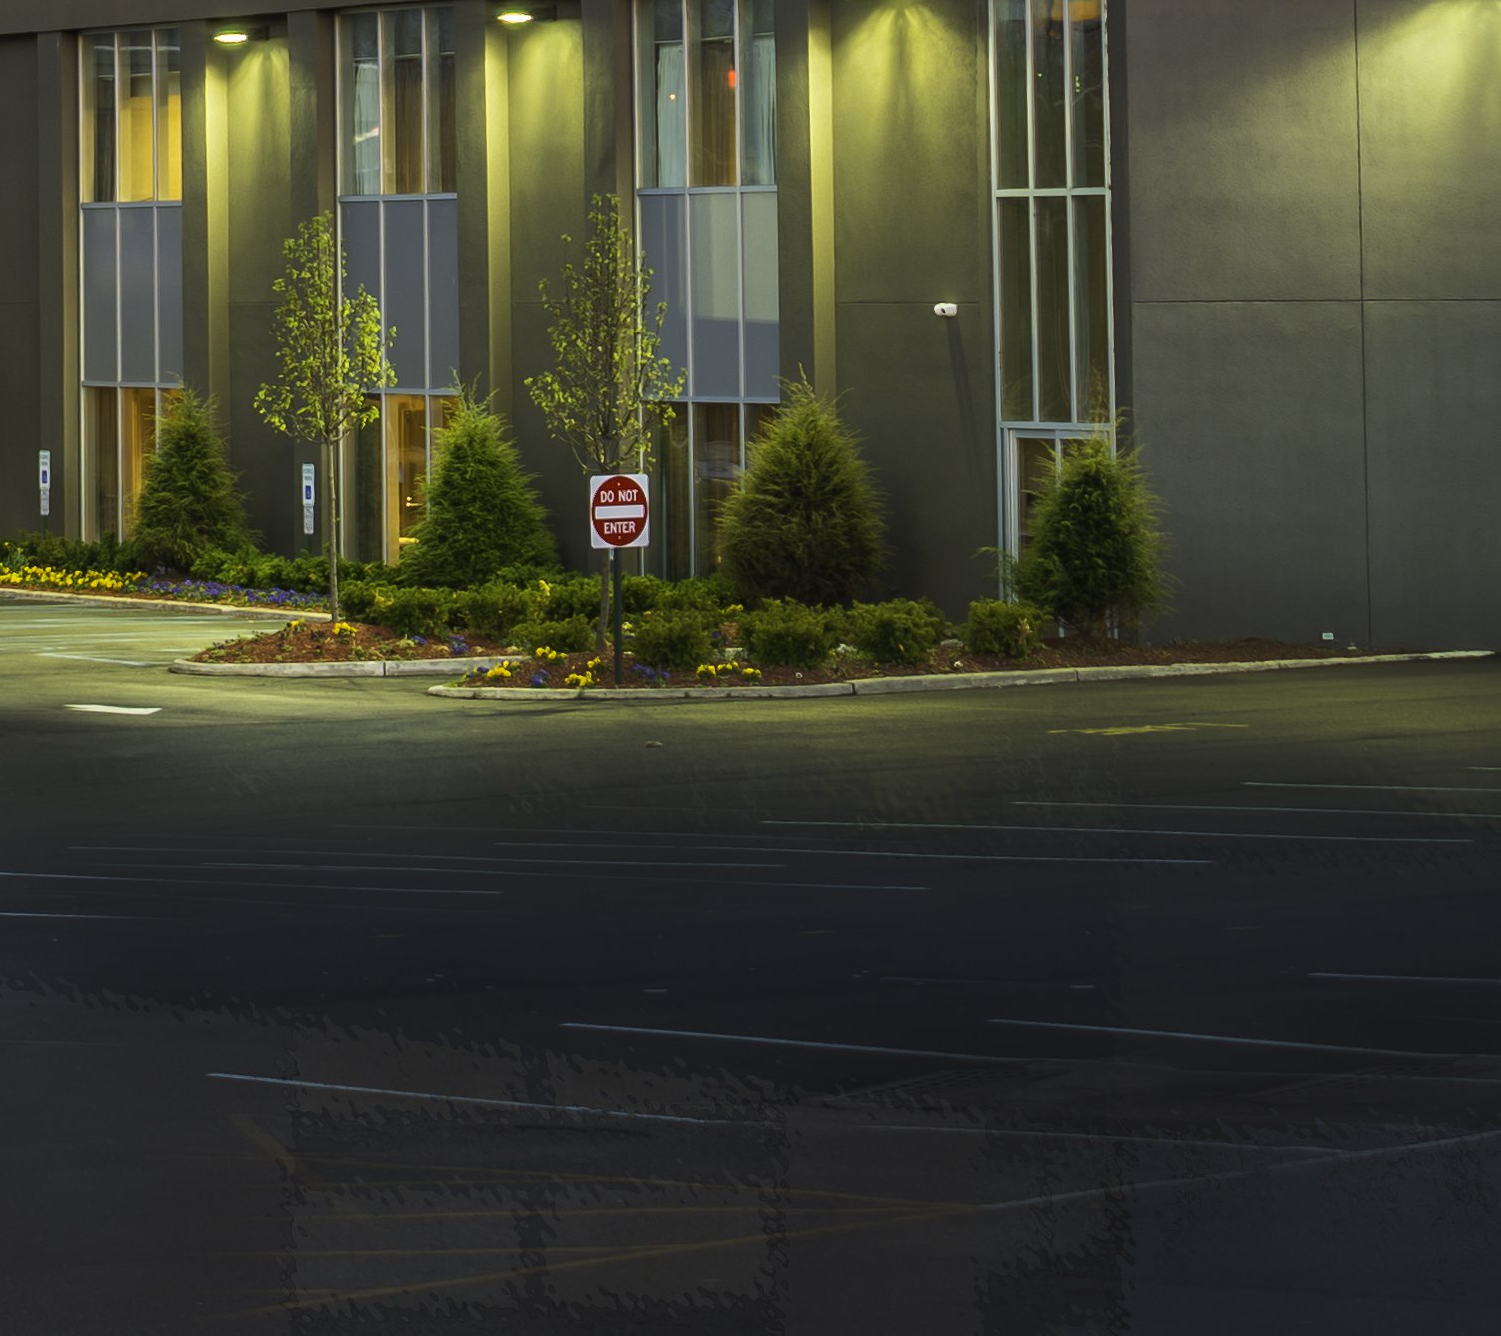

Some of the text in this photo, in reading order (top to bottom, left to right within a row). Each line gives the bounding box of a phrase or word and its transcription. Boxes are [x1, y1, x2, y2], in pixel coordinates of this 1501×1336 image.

[600, 489, 638, 503] DO NOT
[603, 520, 637, 535] ENTER
